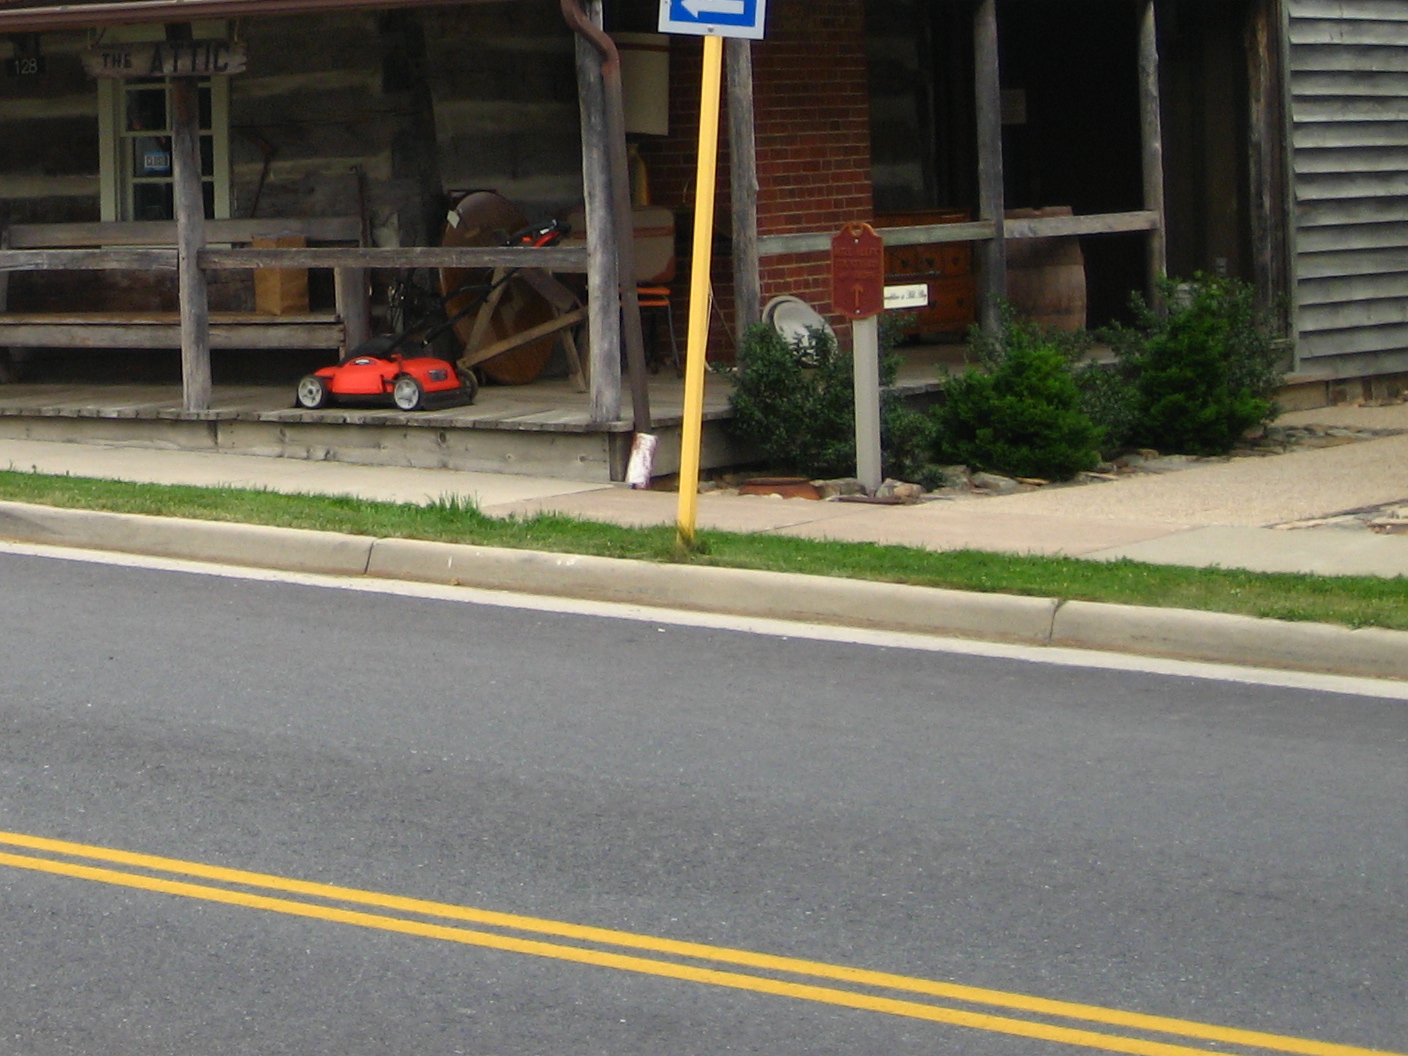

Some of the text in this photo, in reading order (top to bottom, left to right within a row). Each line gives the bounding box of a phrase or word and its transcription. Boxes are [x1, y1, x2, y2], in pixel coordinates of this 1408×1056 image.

[14, 58, 39, 75] 128
[102, 39, 230, 74] THE ATTIC
